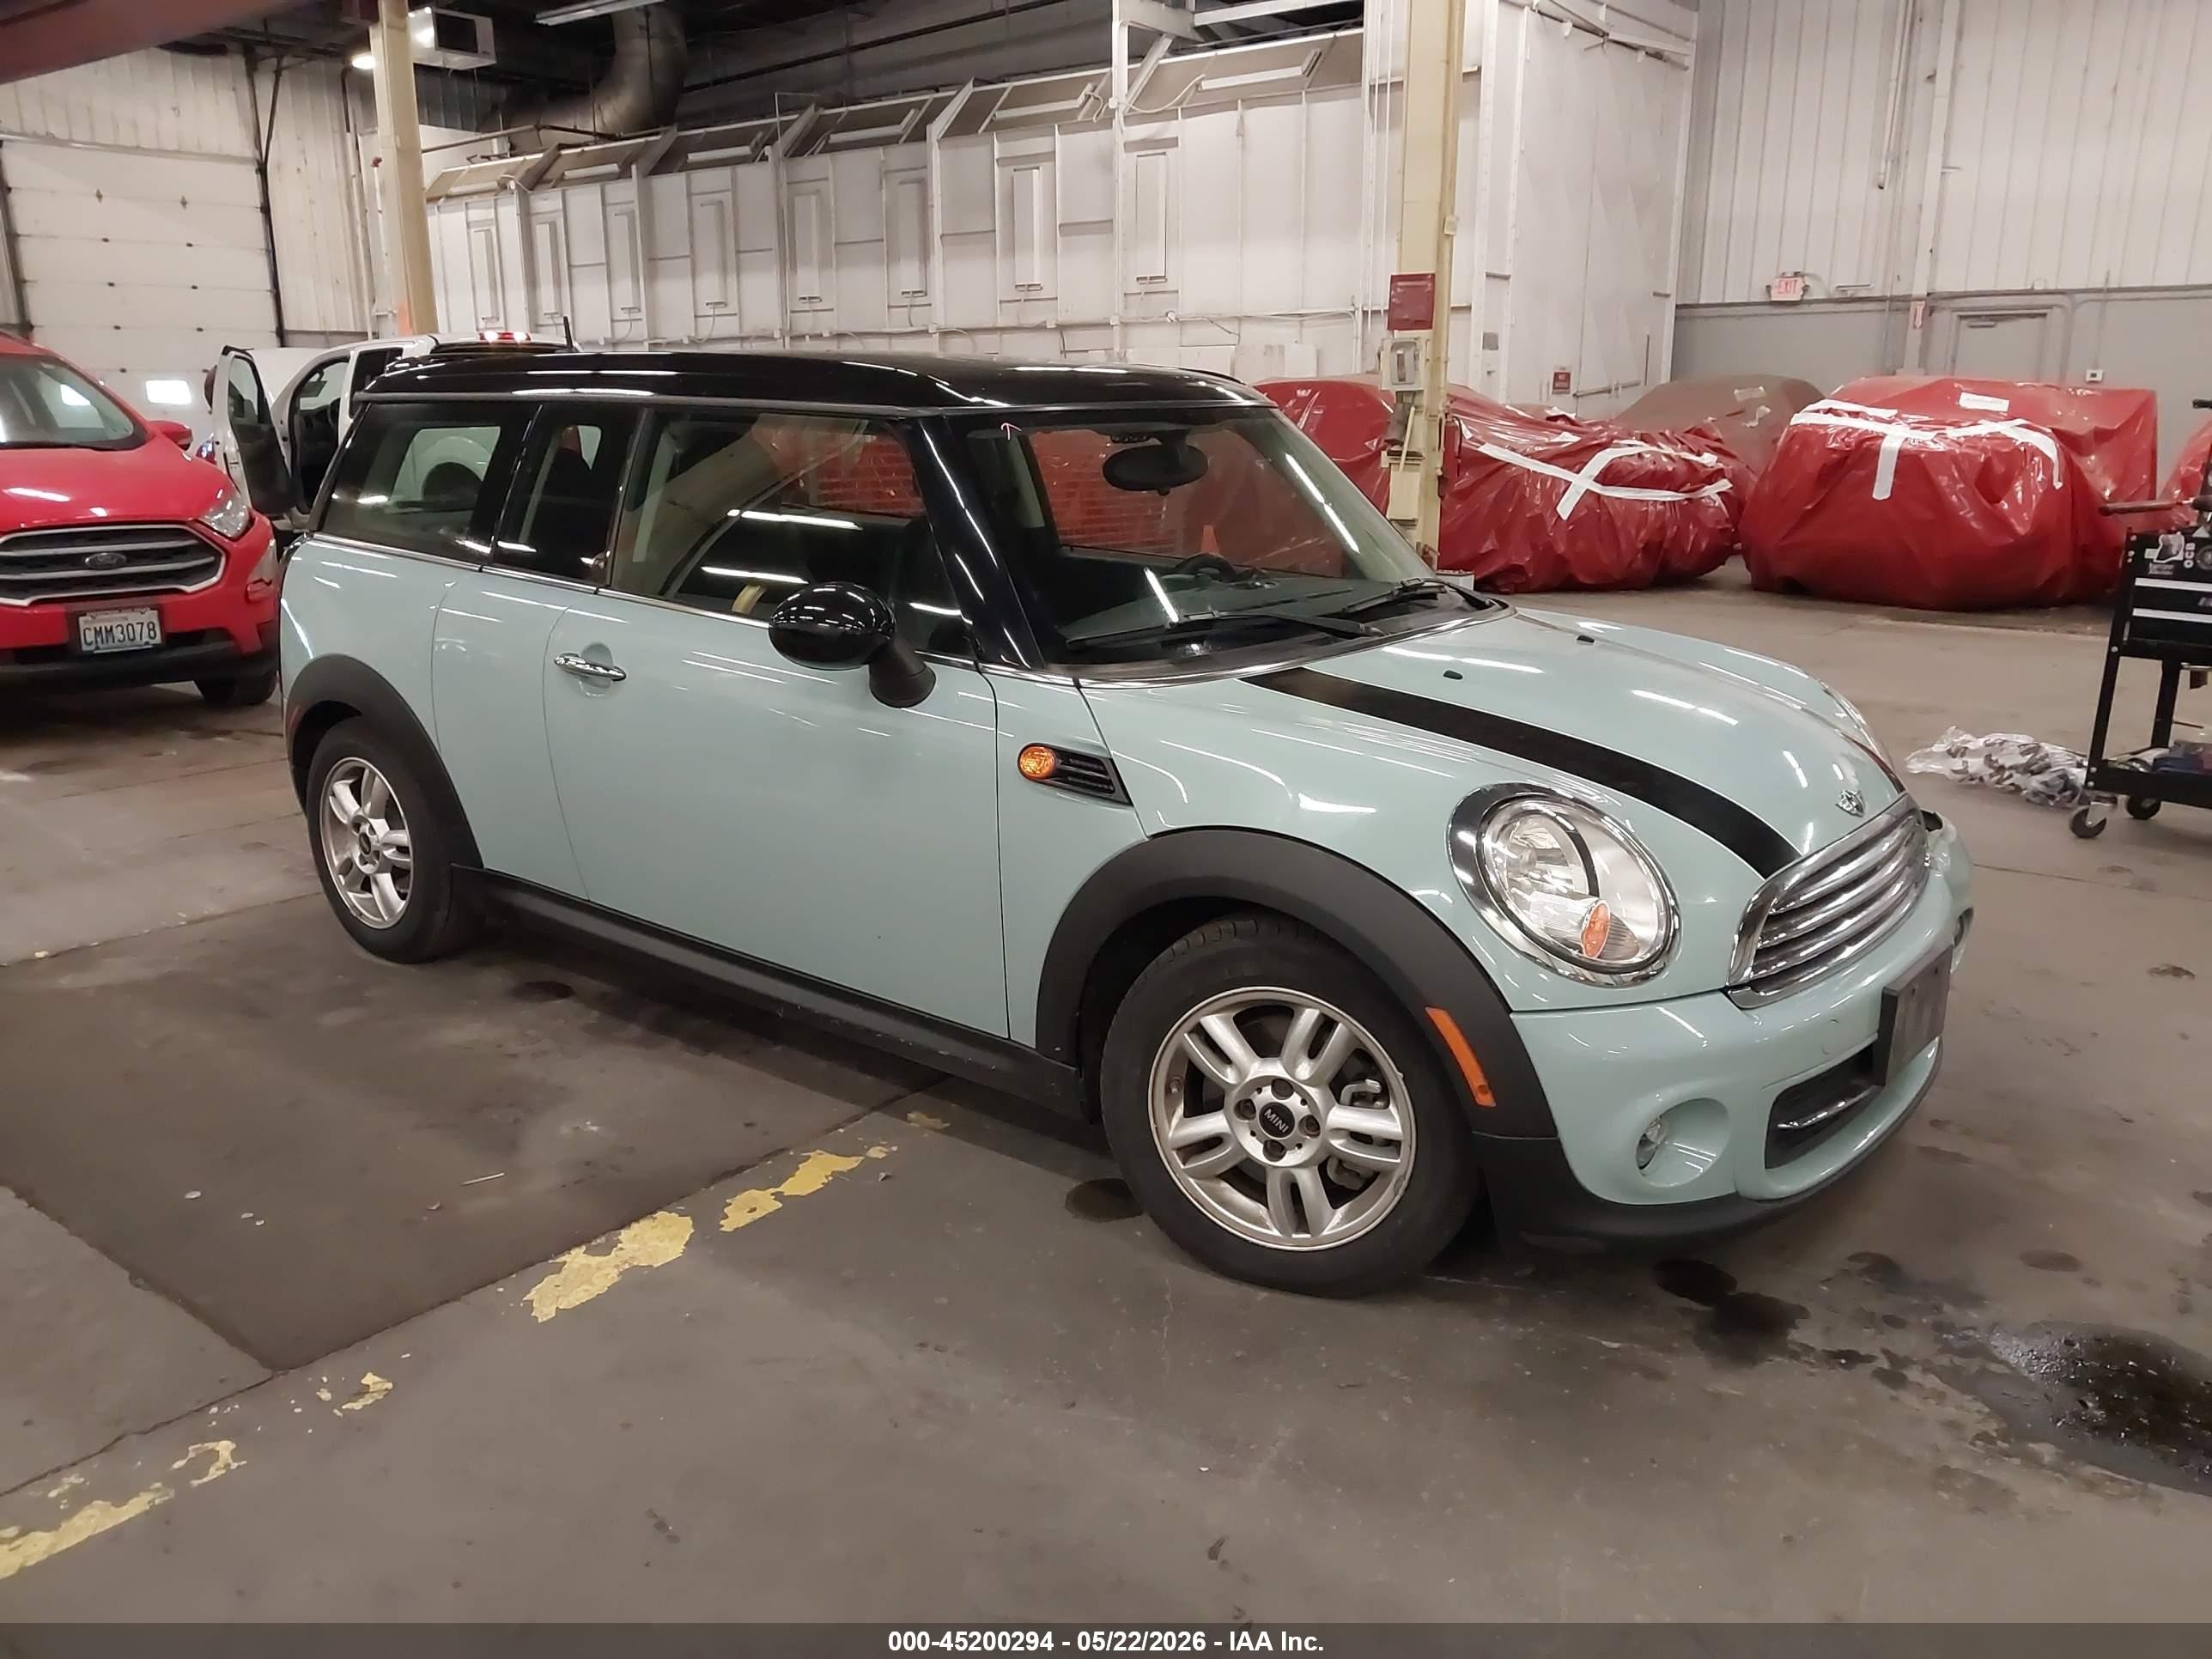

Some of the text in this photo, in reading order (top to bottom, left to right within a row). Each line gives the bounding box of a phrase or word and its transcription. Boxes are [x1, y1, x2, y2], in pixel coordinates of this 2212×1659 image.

[1778, 279, 1799, 295] EXIT
[82, 621, 157, 647] CMM3078
[1263, 1108, 1290, 1133] MINI
